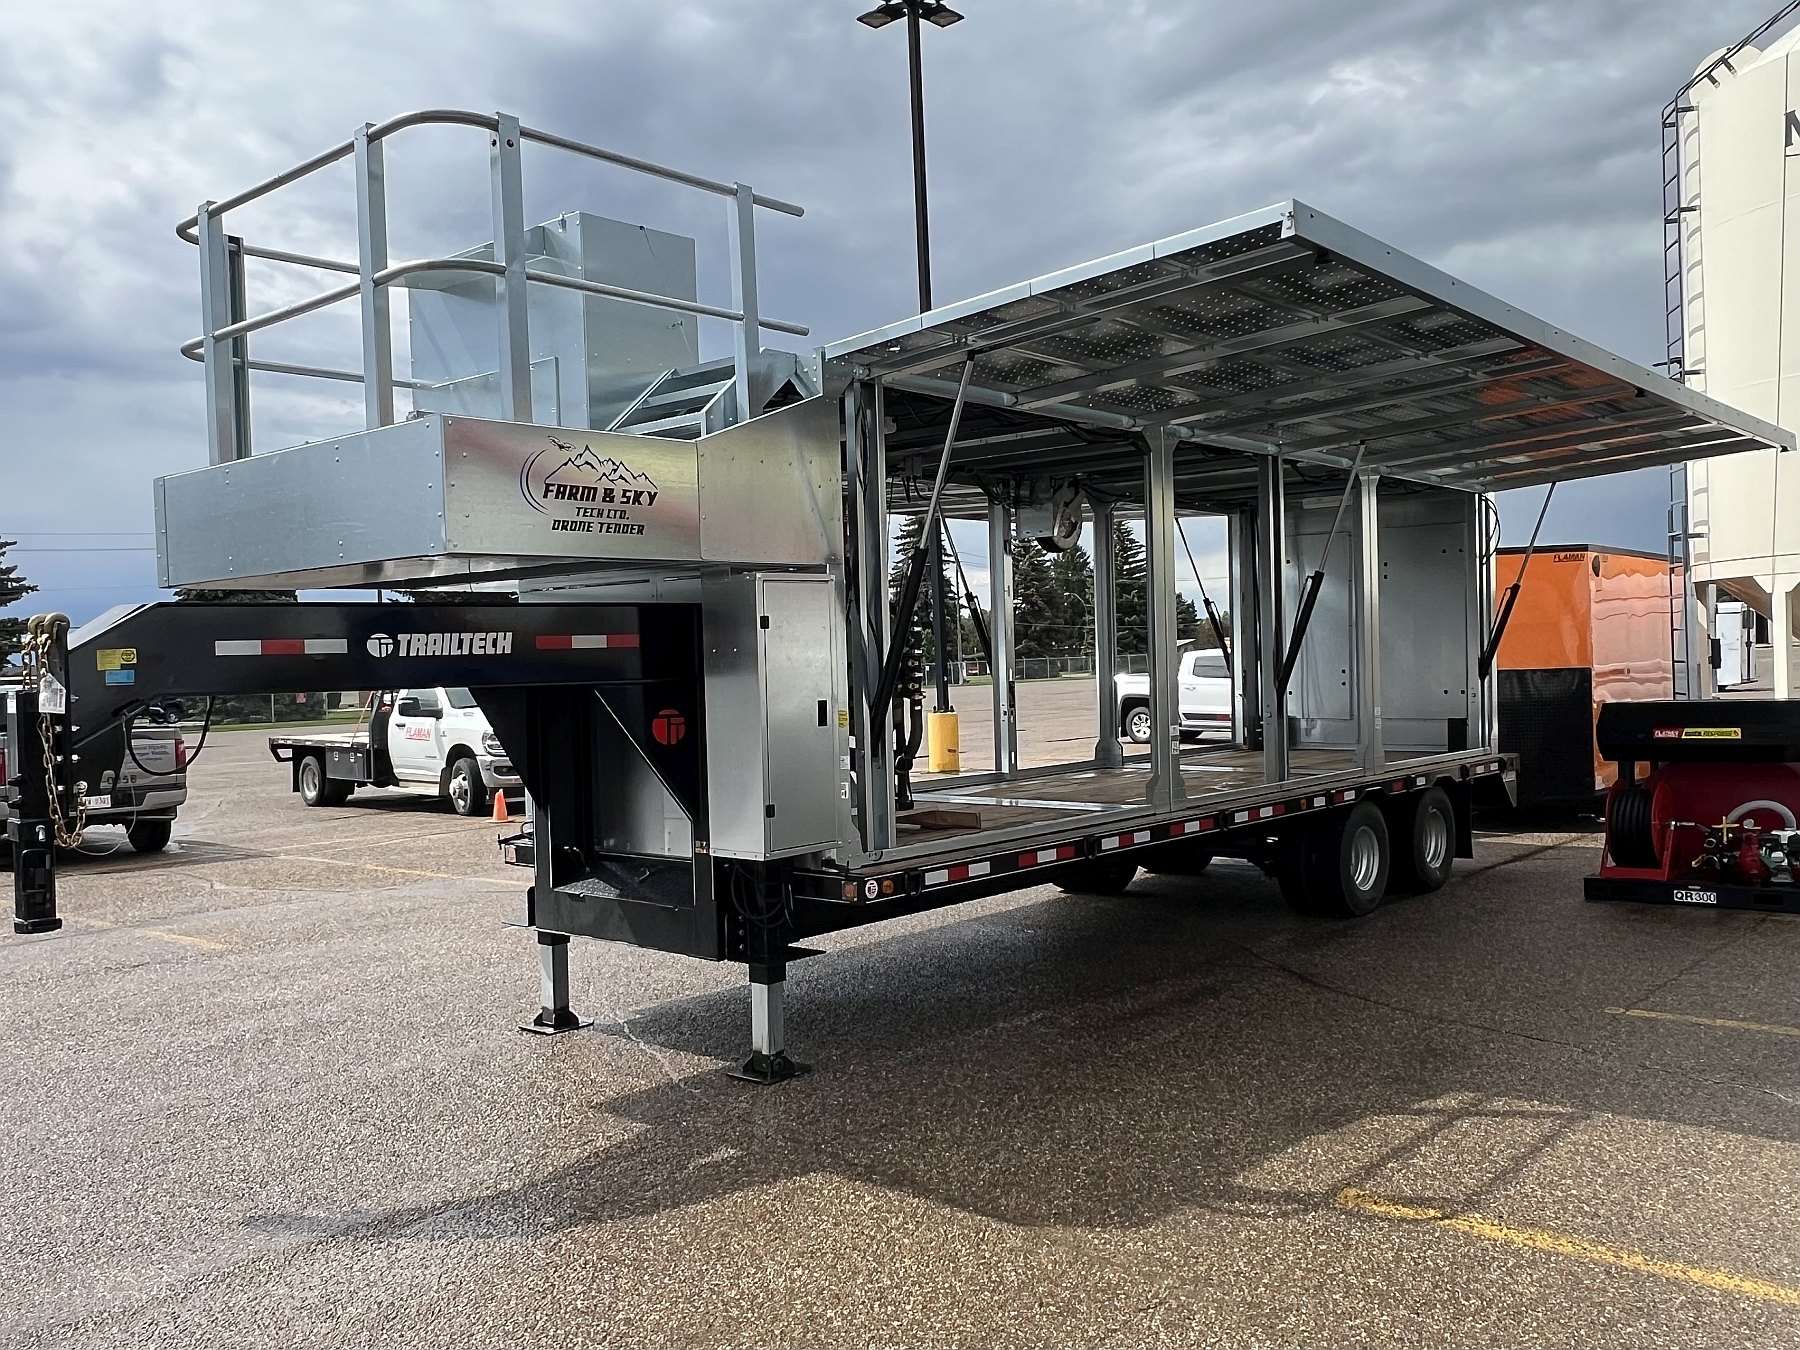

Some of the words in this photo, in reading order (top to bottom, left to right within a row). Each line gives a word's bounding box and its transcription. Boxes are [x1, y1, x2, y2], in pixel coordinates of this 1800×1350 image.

[543, 483, 598, 502] FARM
[602, 488, 615, 504] &
[620, 488, 658, 506] SKY
[575, 506, 604, 518] TECH
[606, 509, 630, 520] LTD.
[551, 519, 594, 532] DRONE
[598, 521, 645, 535] TENDER
[397, 631, 513, 657] TRAILTECH
[406, 727, 432, 739] FLAMAN
[1675, 891, 1716, 902] QR300
